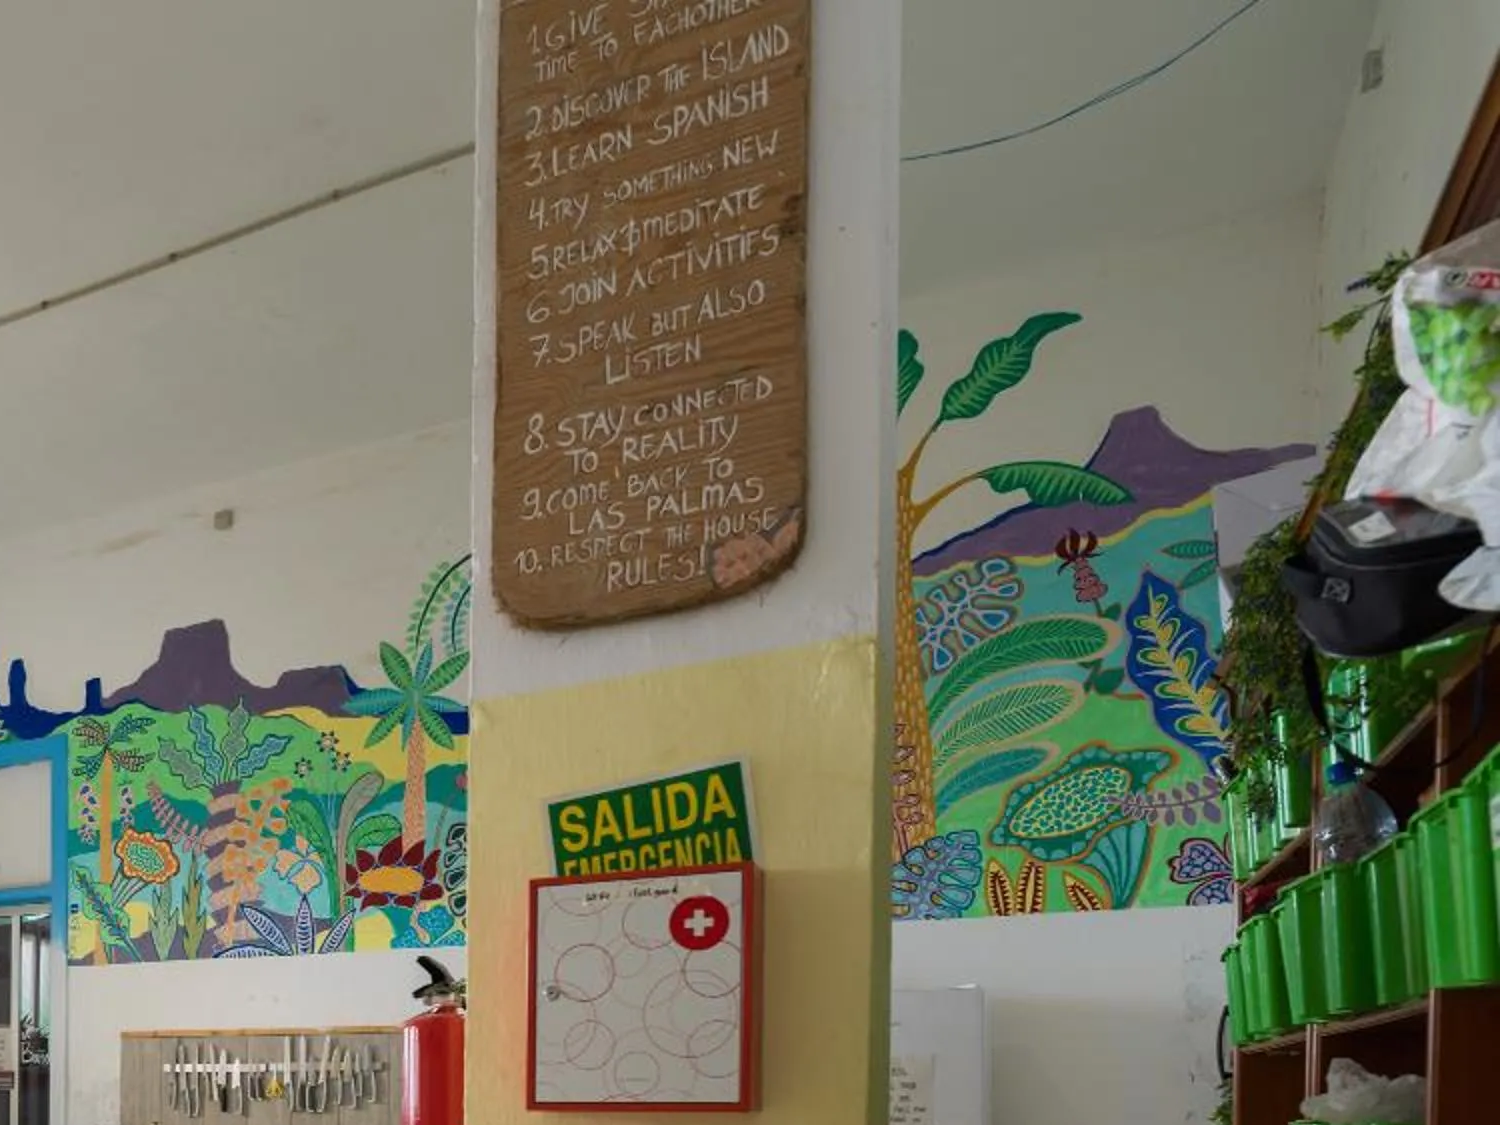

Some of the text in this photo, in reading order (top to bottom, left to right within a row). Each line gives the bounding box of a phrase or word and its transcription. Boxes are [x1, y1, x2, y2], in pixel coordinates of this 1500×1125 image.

[533, 51, 579, 81] TIME
[590, 31, 617, 60] TO
[657, 63, 690, 92] THE
[702, 23, 789, 80] ISLAND
[551, 122, 633, 176] LEARN
[647, 75, 768, 145] SPANISH
[602, 154, 713, 208] SOMETHING
[722, 129, 779, 170] NEW
[558, 269, 617, 314] JOIN
[626, 223, 780, 297] ACTIVITIES
[553, 311, 638, 363] SPEAK
[650, 305, 692, 337] BUT
[697, 279, 766, 325] ALSO
[605, 331, 701, 385] LISTEN
[556, 405, 627, 449] STAY
[633, 374, 773, 426] CONNECTED
[563, 414, 739, 475] TO REALITY
[545, 480, 610, 514] COME
[626, 463, 691, 499] BACK
[701, 457, 734, 482] TO
[568, 476, 765, 535] LAS PALMAS
[550, 527, 652, 569] RESPECT
[665, 522, 695, 550] THE
[702, 506, 776, 544] HOUSE
[559, 772, 737, 853] SALIDA
